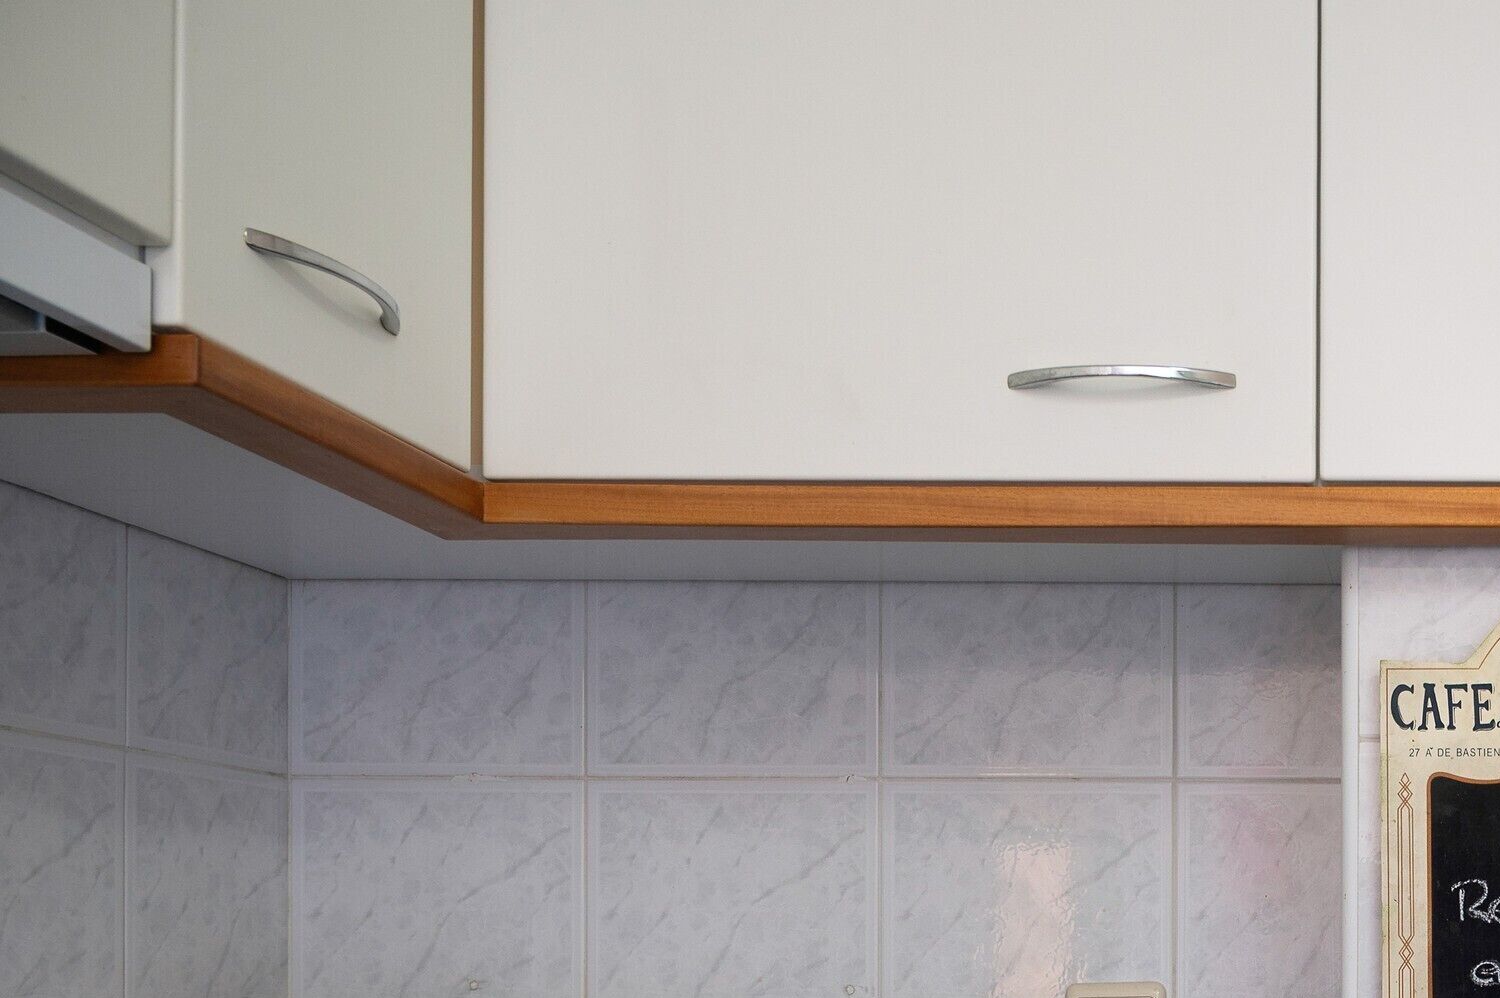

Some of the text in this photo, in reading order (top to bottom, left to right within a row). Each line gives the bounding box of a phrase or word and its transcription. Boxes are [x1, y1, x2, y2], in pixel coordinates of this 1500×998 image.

[1390, 683, 1496, 732] CAFE
[1409, 748, 1420, 757] 27
[1437, 748, 1451, 757] DE
[1456, 748, 1500, 757] BASTIEN
